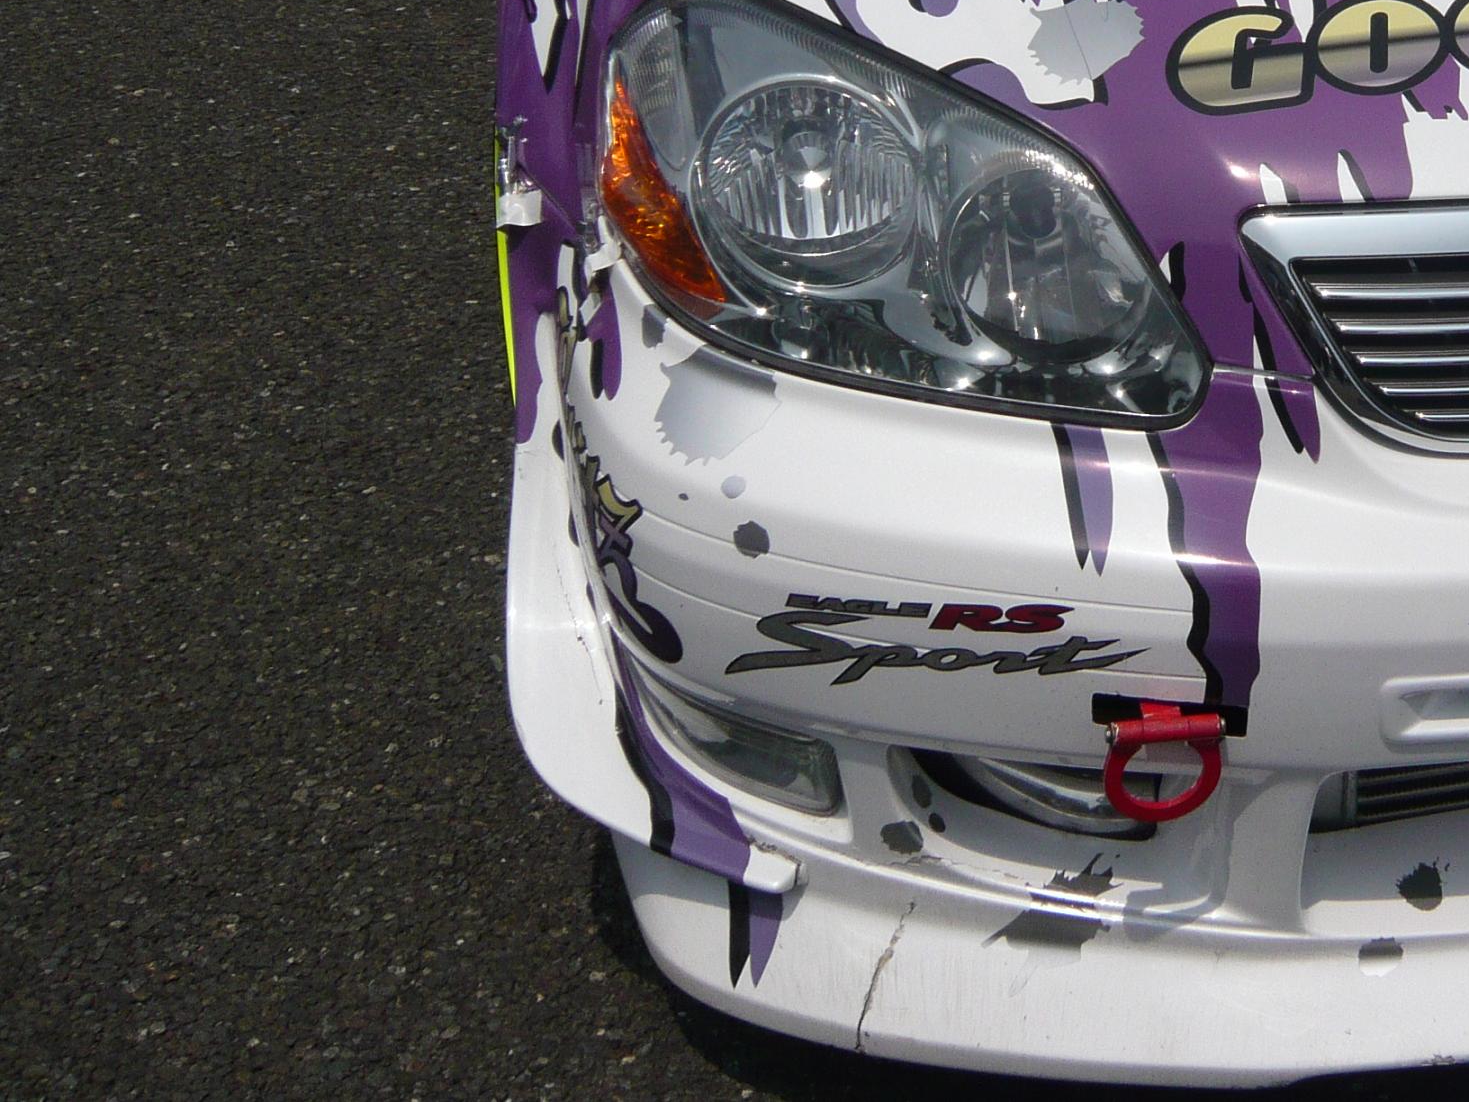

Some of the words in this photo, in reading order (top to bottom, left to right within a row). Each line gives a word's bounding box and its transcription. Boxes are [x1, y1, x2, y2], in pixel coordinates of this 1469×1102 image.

[786, 592, 934, 619] EAGLE
[928, 603, 1075, 634] RS
[724, 609, 1153, 687] Sport
